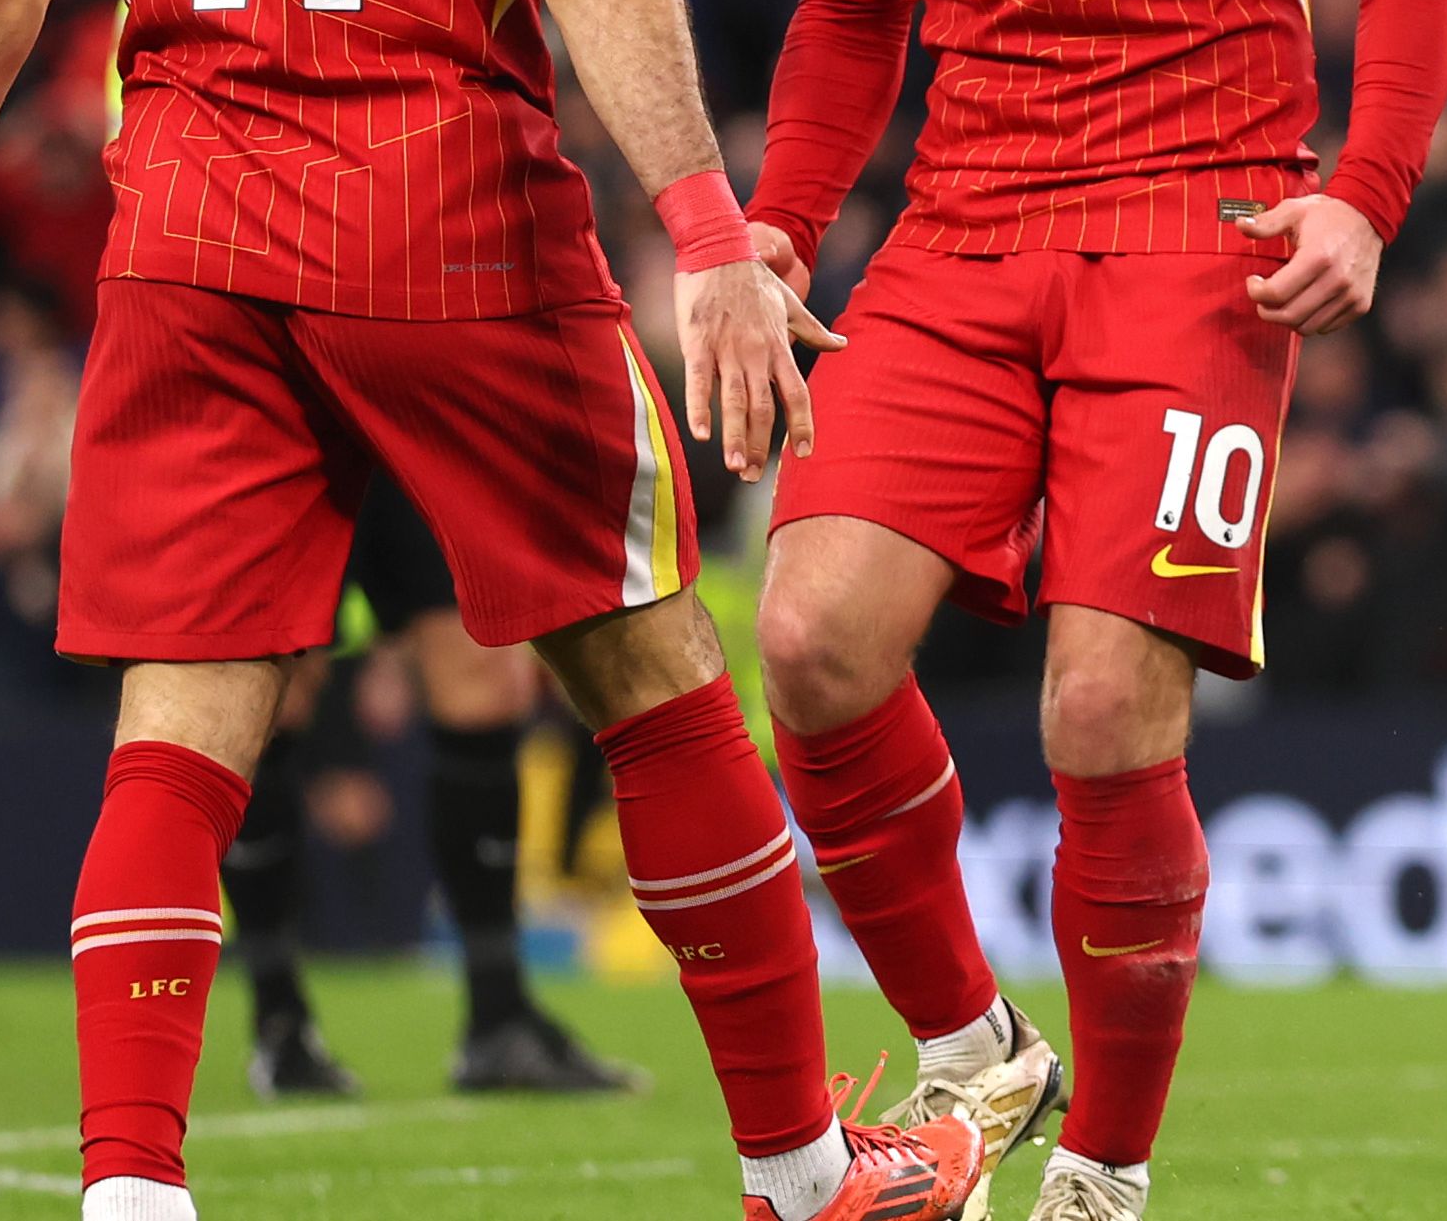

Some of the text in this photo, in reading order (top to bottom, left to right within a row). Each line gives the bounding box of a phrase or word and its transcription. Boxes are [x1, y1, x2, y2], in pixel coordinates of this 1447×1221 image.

[1154, 407, 1266, 550] 10
[666, 943, 726, 961] LFC
[129, 978, 191, 1000] LFC
